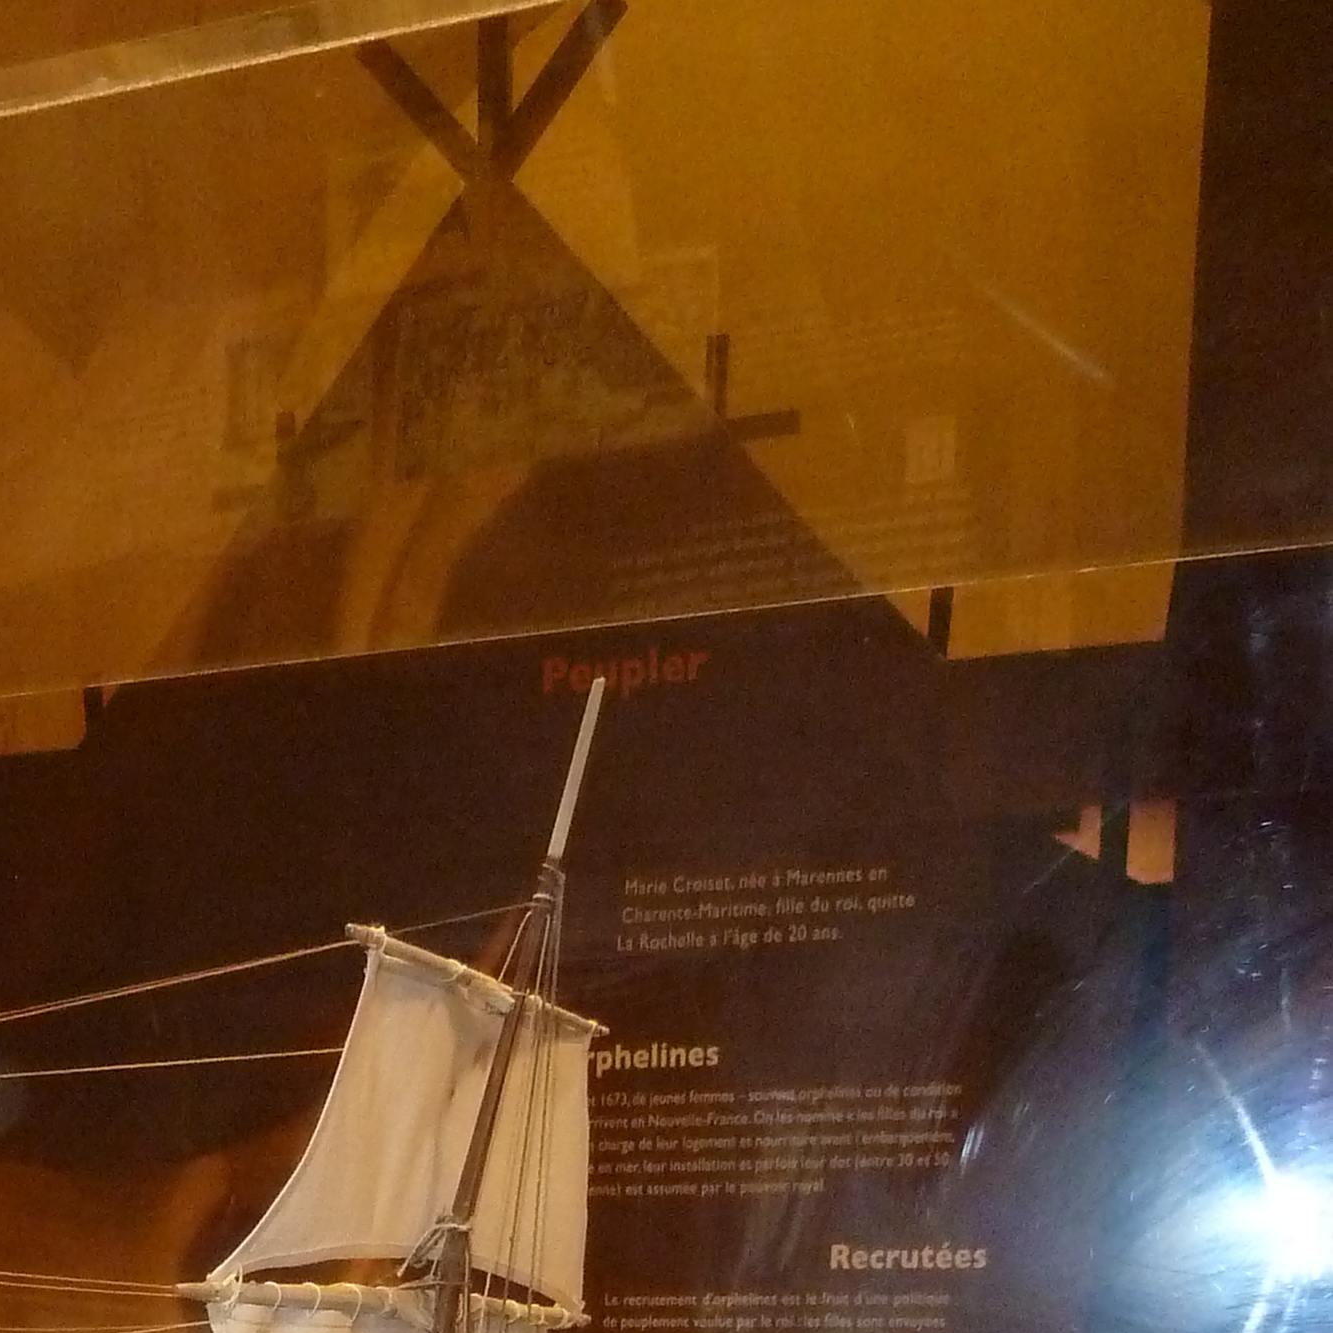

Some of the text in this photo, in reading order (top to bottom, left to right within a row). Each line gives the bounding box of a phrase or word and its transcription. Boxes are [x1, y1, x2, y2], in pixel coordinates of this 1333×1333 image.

[543, 648, 708, 699] Peupler
[624, 879, 667, 895] Marie
[738, 872, 766, 890] née
[786, 867, 863, 887] Marennes
[868, 868, 888, 882] en
[776, 896, 804, 914] fille
[810, 896, 829, 913] du
[867, 894, 916, 912] quitte
[616, 934, 634, 951] La
[639, 928, 703, 950] Rochelle
[763, 927, 782, 944] de
[788, 924, 808, 942] 20
[587, 1042, 719, 1078] rphelines
[632, 1092, 647, 1106] de
[649, 1092, 686, 1107] jeunes
[689, 1089, 734, 1104] femmes
[589, 1115, 628, 1129] rrivent
[631, 1115, 645, 1128] en
[599, 1137, 635, 1154] charge
[638, 1137, 653, 1151] de
[655, 1135, 678, 1151] leur
[682, 1134, 736, 1153] logement
[642, 1159, 666, 1173] leur
[669, 1157, 736, 1172] installation
[700, 1183, 721, 1198] par
[724, 1180, 736, 1194] le
[830, 1242, 987, 1270] Recrutées
[604, 1293, 619, 1307] Le
[623, 1295, 697, 1307] recrutement
[603, 1315, 617, 1328] de
[620, 1314, 689, 1331] peuplement
[736, 1317, 757, 1332] par
[760, 1314, 773, 1327] le
